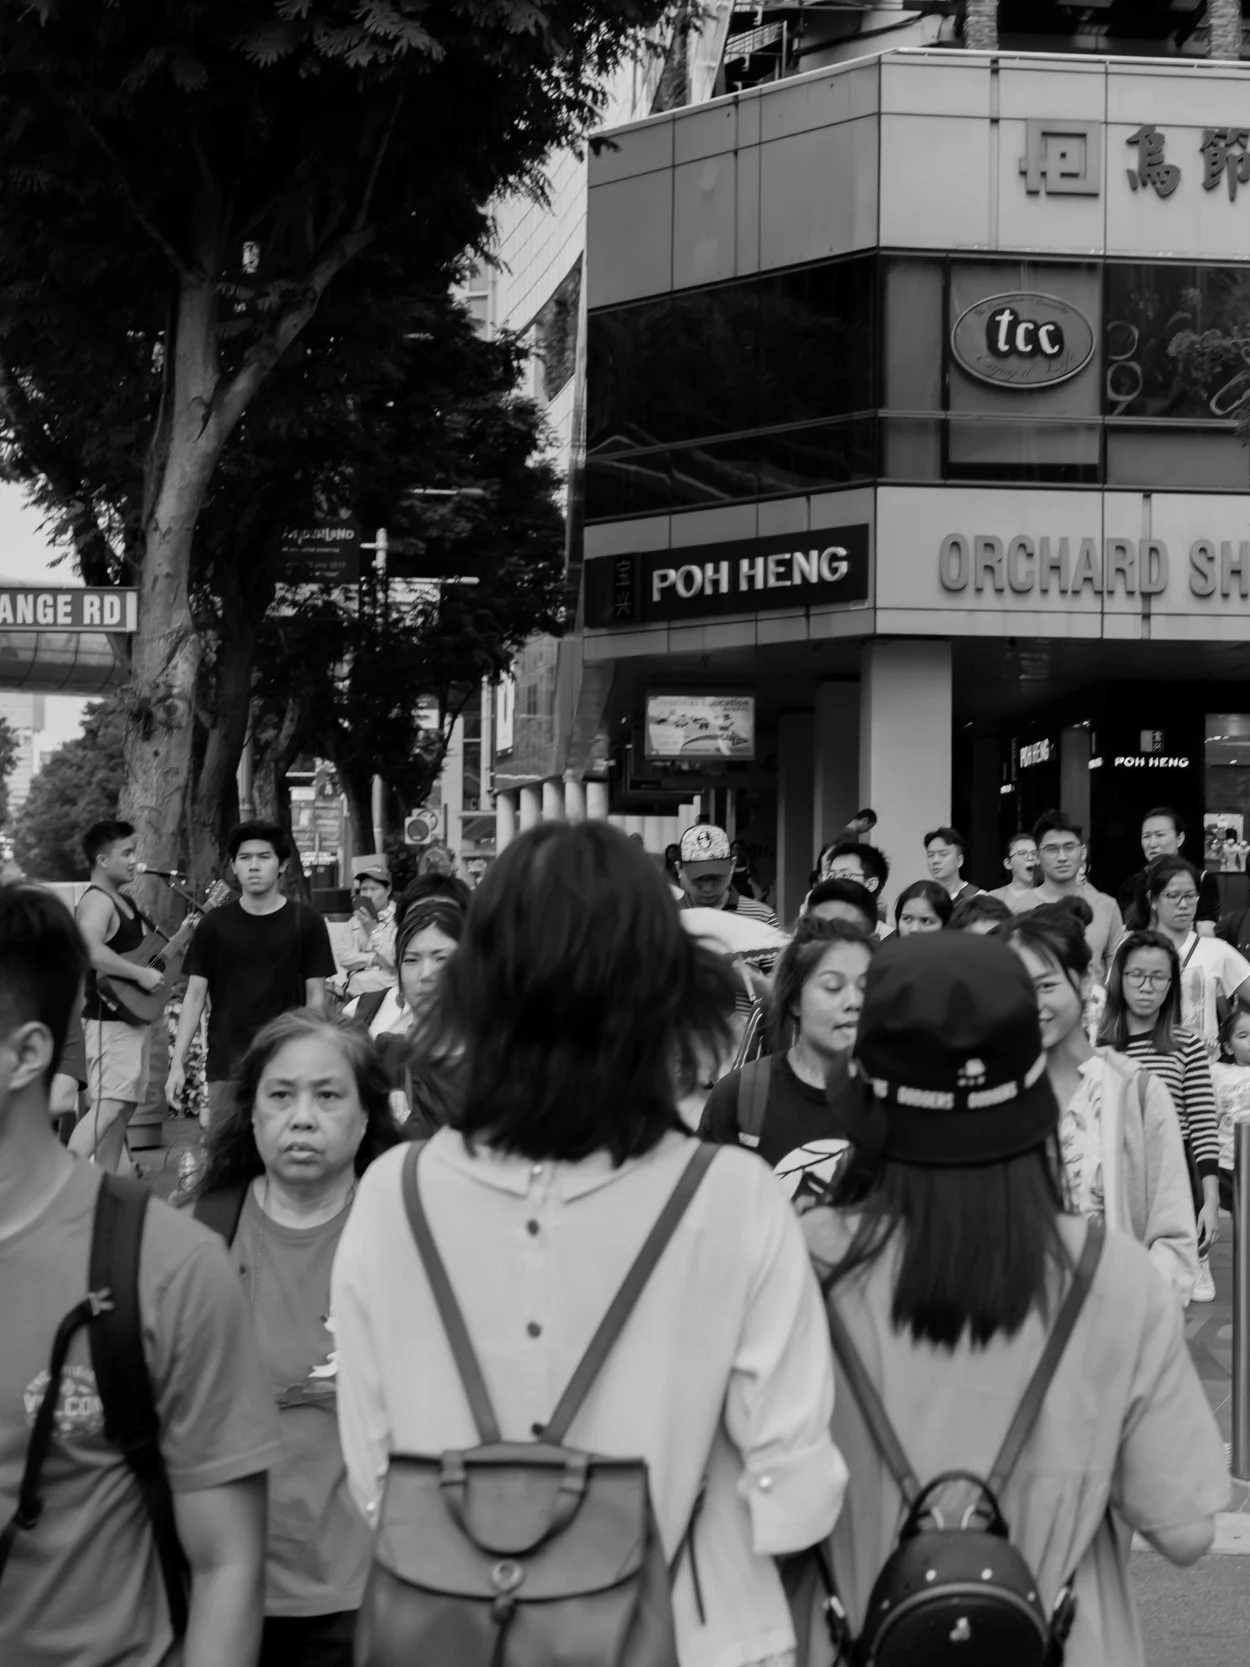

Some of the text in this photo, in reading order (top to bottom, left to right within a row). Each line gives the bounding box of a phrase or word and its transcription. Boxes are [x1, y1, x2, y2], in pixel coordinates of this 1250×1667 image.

[994, 308, 1060, 355] tcc
[652, 546, 849, 602] POH HENG
[939, 533, 1169, 596] ORCHARD
[0, 594, 121, 625] ANGE RD
[1114, 757, 1145, 768] POH
[1148, 757, 1190, 768] HENG
